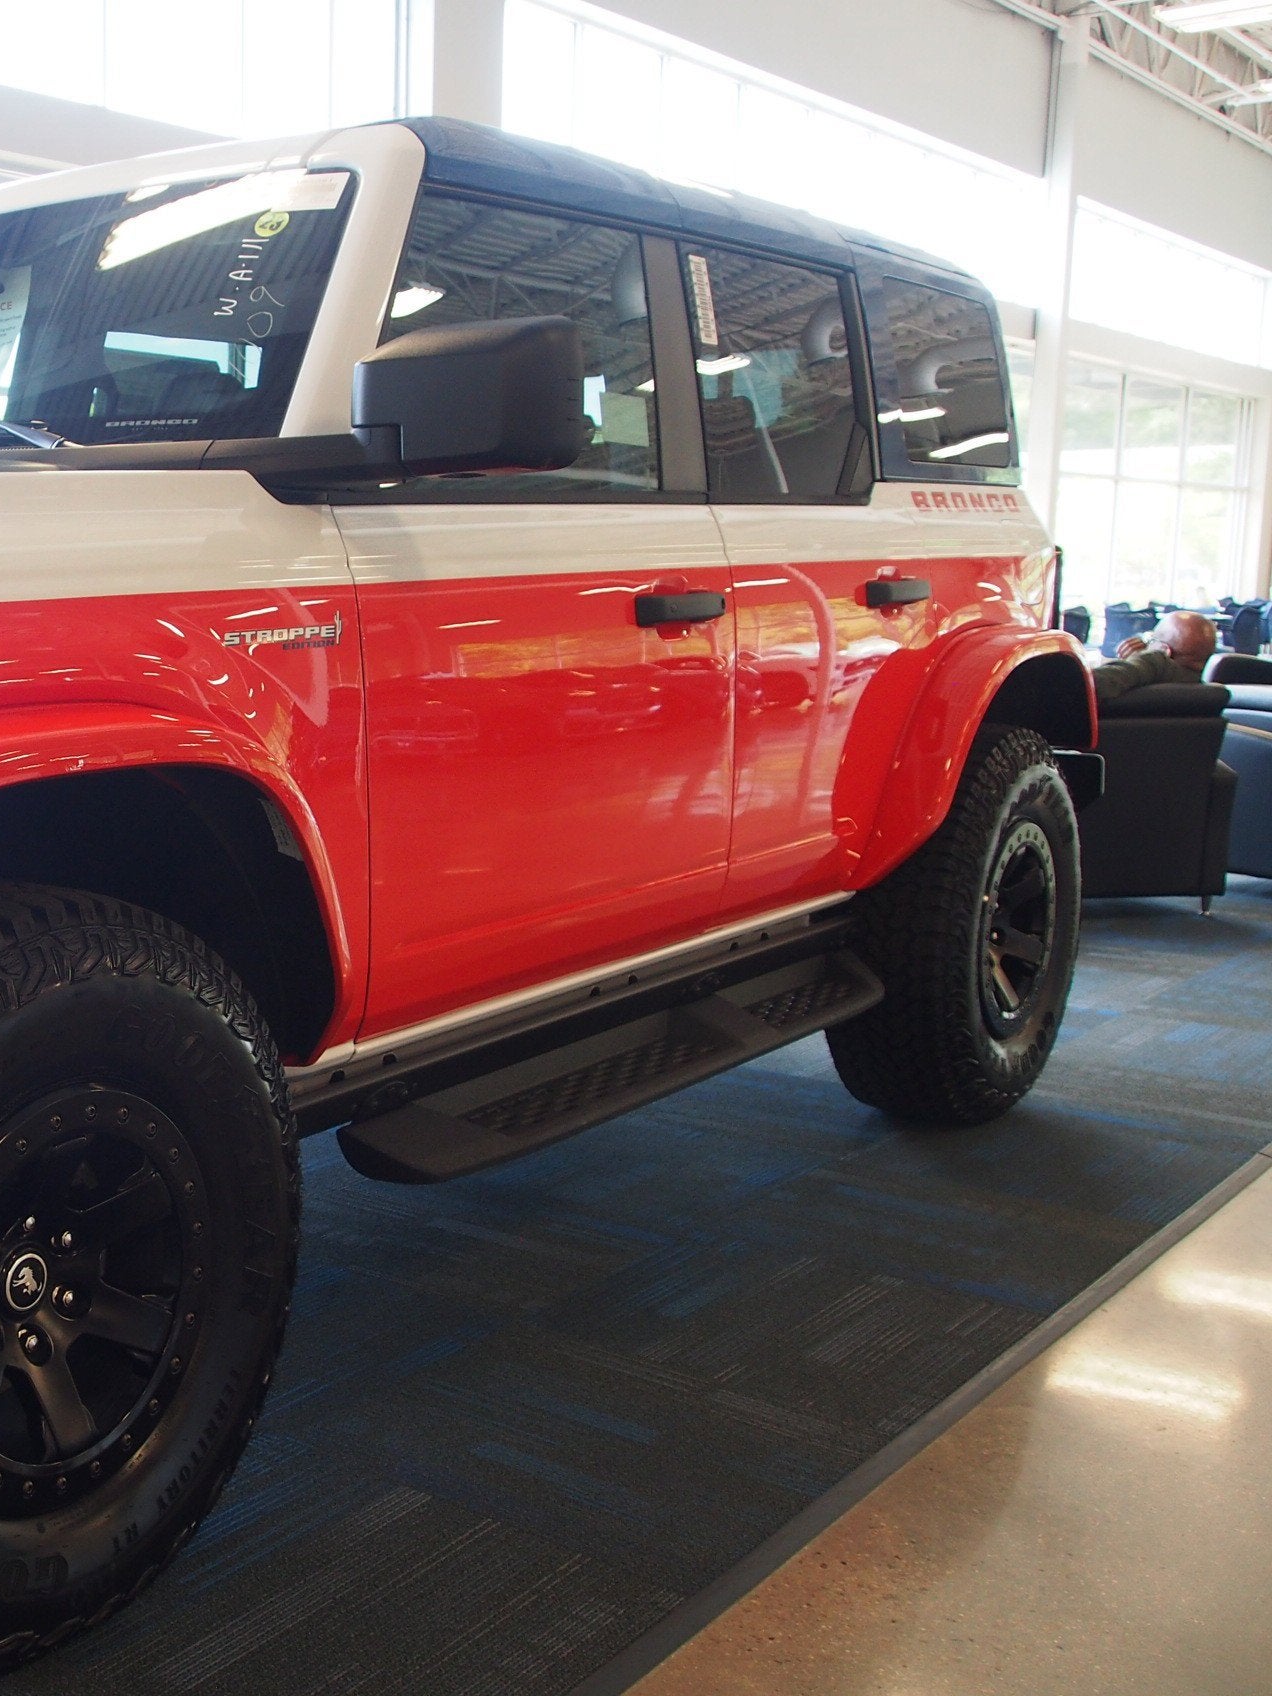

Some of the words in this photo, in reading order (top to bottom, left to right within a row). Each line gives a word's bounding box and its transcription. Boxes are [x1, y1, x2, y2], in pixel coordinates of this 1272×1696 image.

[911, 491, 1021, 513] BRONCO
[224, 625, 335, 646] STROPPE
[282, 639, 336, 650] EDITION
